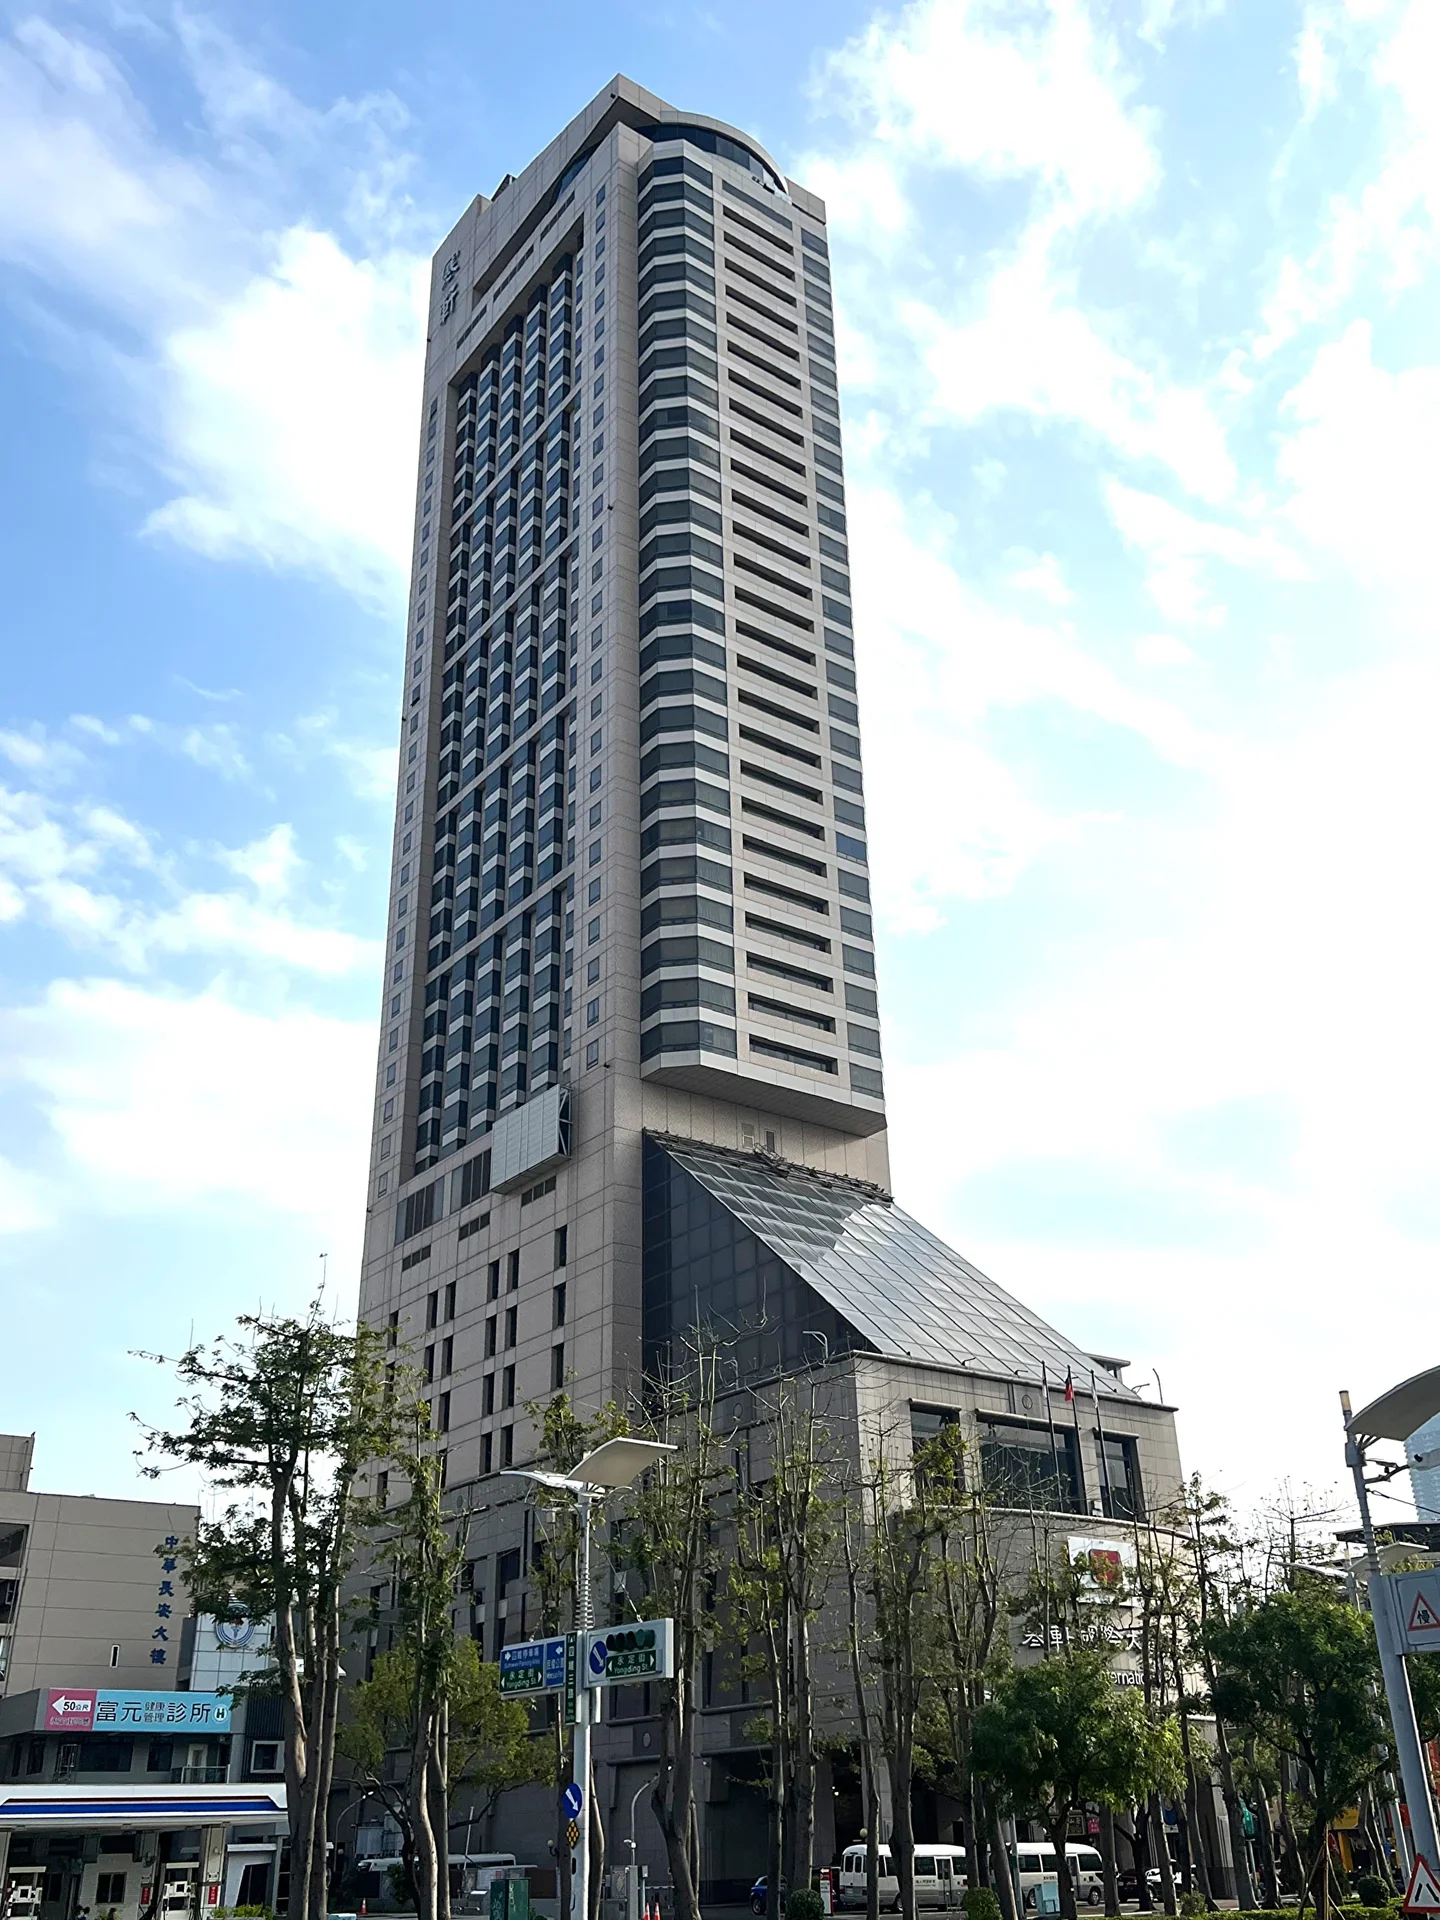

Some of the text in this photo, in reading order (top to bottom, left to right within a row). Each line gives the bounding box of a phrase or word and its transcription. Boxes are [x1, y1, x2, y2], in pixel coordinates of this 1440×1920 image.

[1417, 1609, 1430, 1625] 慢
[617, 1653, 646, 1666] 永定街
[509, 1668, 535, 1680] 永定街
[614, 1664, 641, 1675] Yongding
[96, 1701, 143, 1723] 富元
[166, 1702, 211, 1723] 診所
